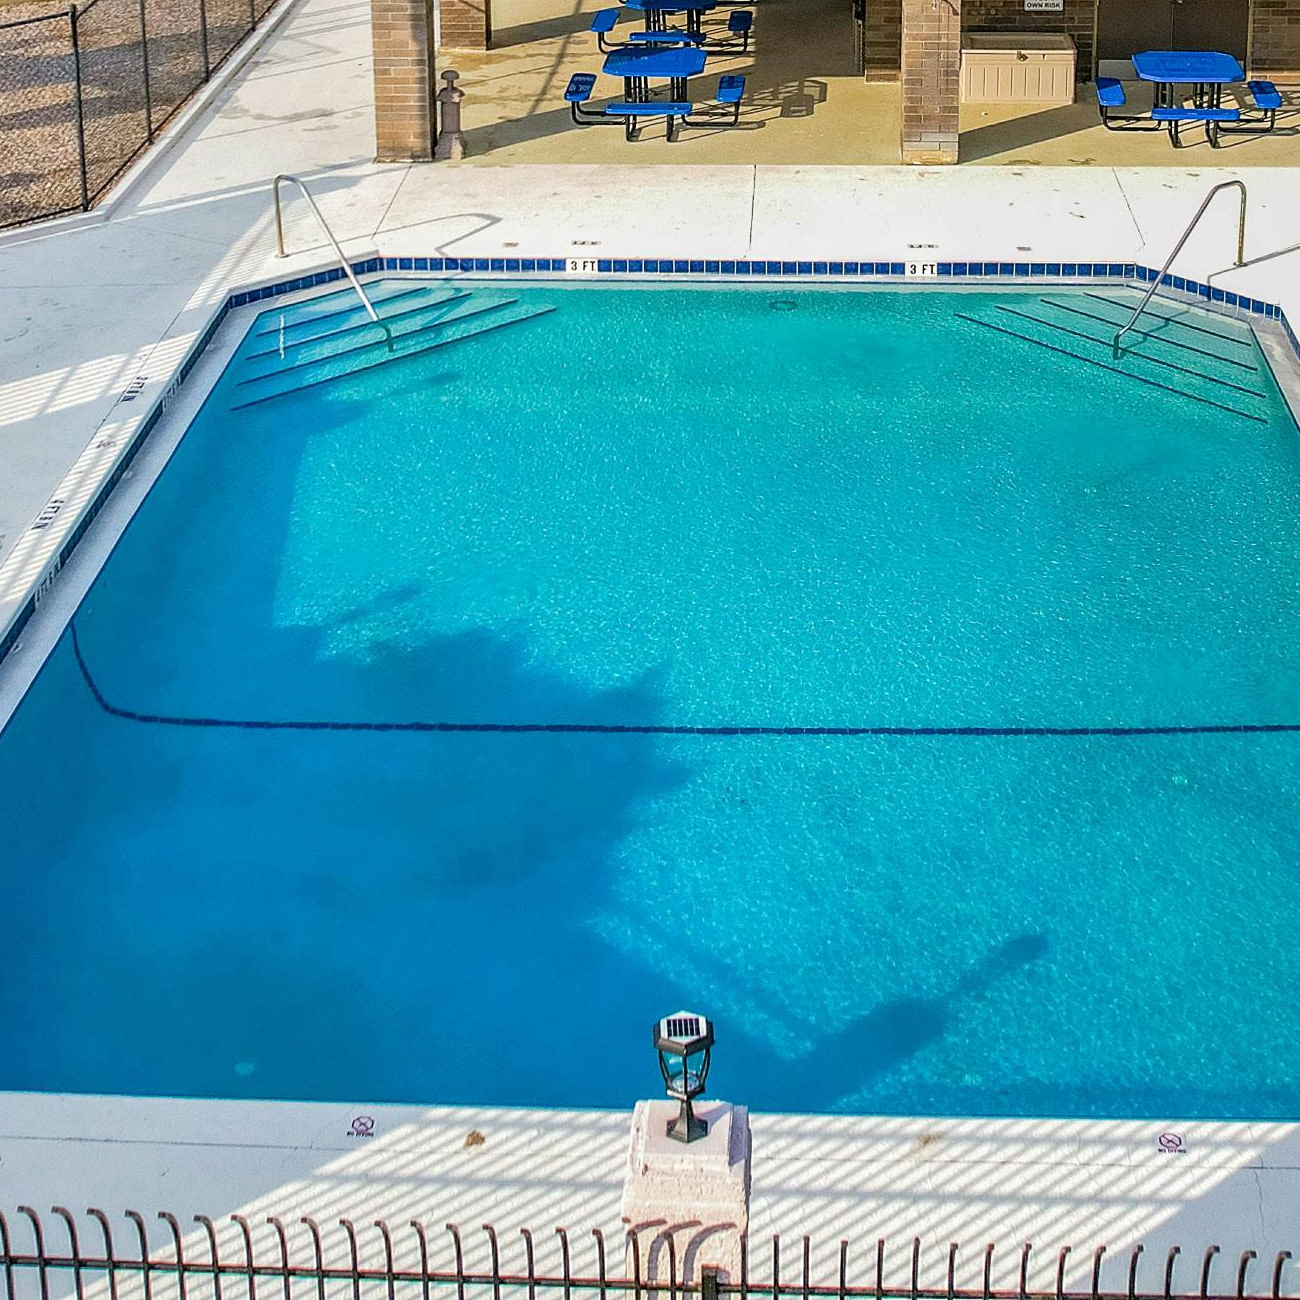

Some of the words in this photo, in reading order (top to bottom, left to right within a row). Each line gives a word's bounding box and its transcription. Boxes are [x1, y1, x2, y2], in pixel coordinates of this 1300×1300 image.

[571, 260, 577, 271] 3
[583, 260, 596, 271] FT
[910, 264, 916, 275] 3
[922, 264, 935, 275] FT
